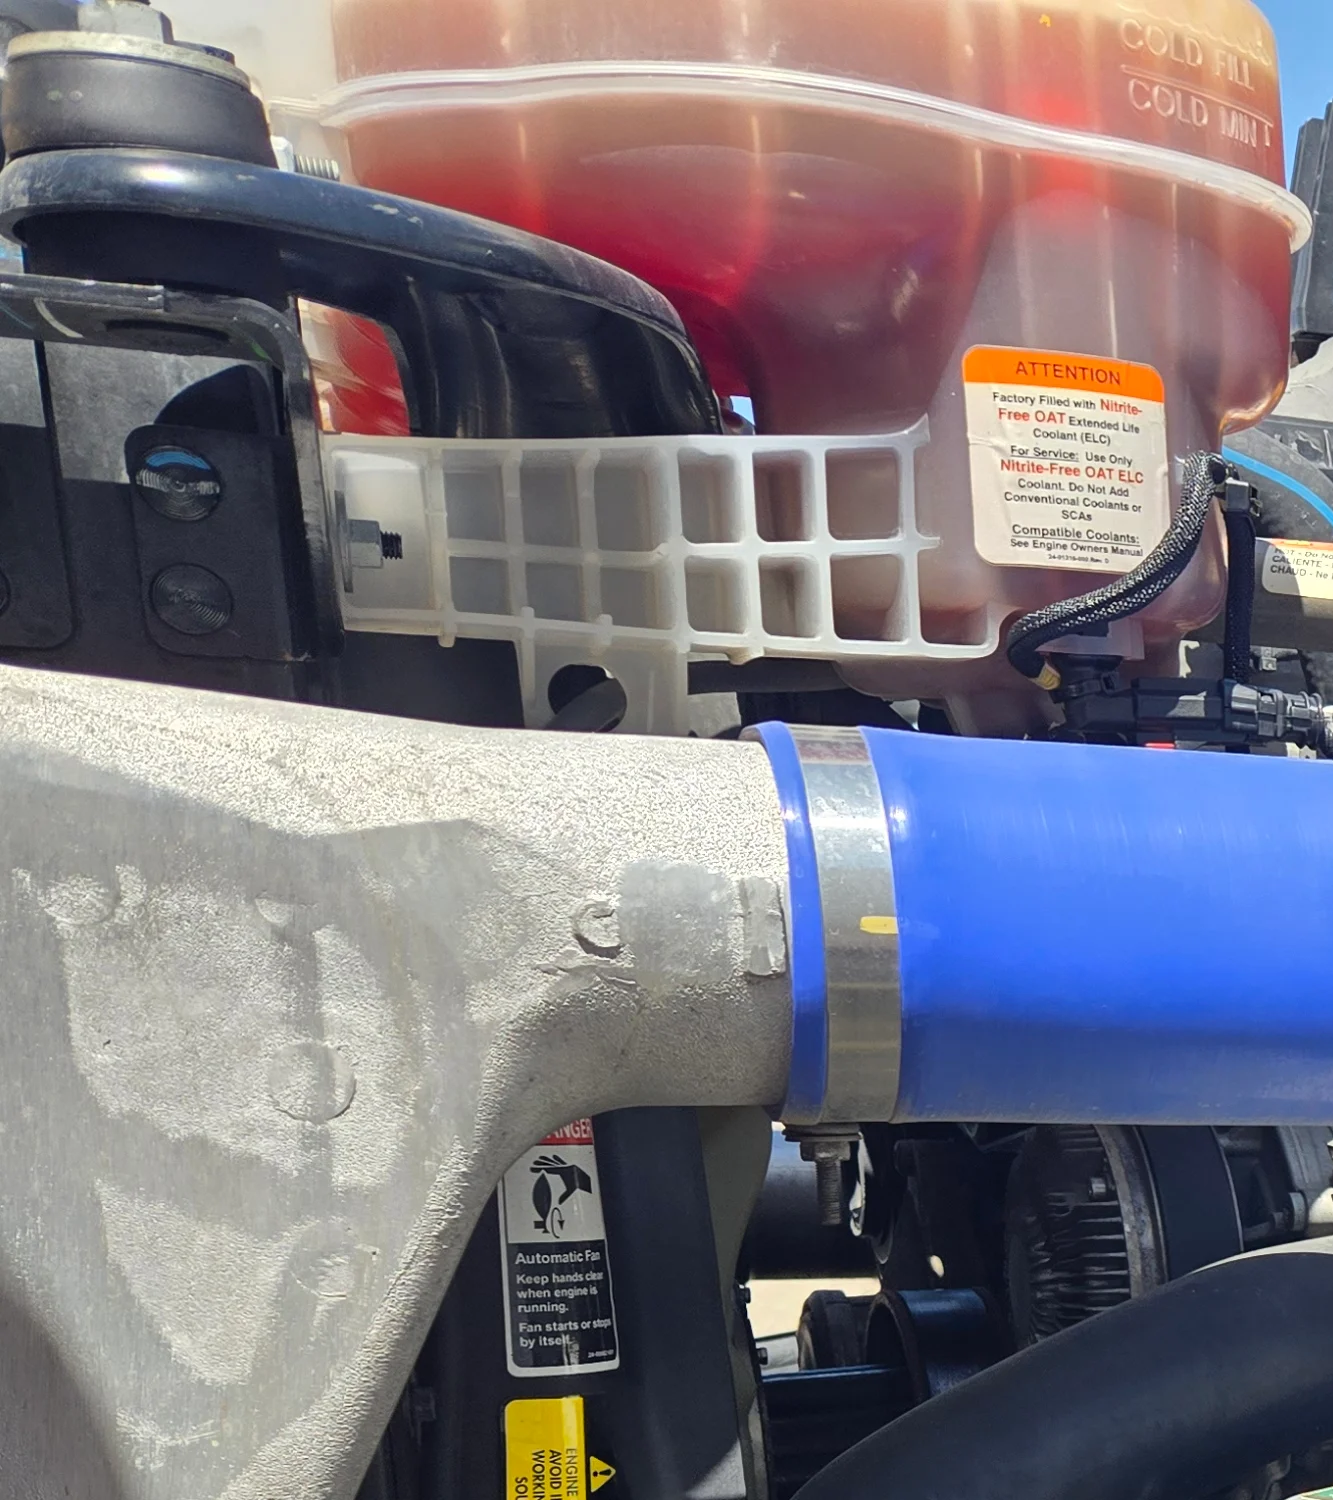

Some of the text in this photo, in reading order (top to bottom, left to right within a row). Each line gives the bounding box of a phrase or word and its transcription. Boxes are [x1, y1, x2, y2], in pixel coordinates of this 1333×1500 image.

[1120, 19, 1255, 91] COLD FILL
[1128, 78, 1257, 148] COLD MIN
[1015, 361, 1121, 386] ATTENTION
[992, 392, 1142, 416] Factory Filled with Nitrite-
[999, 408, 1140, 434] Free OAT Extended Life
[1033, 428, 1111, 446] Coolant (ELC)
[1010, 445, 1133, 467] For Service: Use Only
[1001, 459, 1144, 484] Nitrite-Free OAT ELC
[1018, 478, 1130, 498] Coolant. Do Not Add
[1004, 491, 1142, 512] Conventional Coolants or
[1061, 509, 1092, 521] SCAs
[1012, 524, 1140, 544] Compatible Coolants:
[1010, 538, 1144, 557] See Engine Owners Manual
[1272, 555, 1322, 567] CALIENTE
[1270, 565, 1306, 577] CHAUD
[1316, 571, 1329, 579] Ne
[515, 1250, 600, 1265] Automatic Fan
[516, 1270, 604, 1286] Keep hands clear
[516, 1285, 598, 1300] when engine is
[517, 1302, 569, 1314] running.
[518, 1317, 612, 1333] Fan starts or stops
[519, 1336, 535, 1350] by
[549, 1449, 562, 1490] AVOID
[566, 1448, 578, 1497] ENGINE
